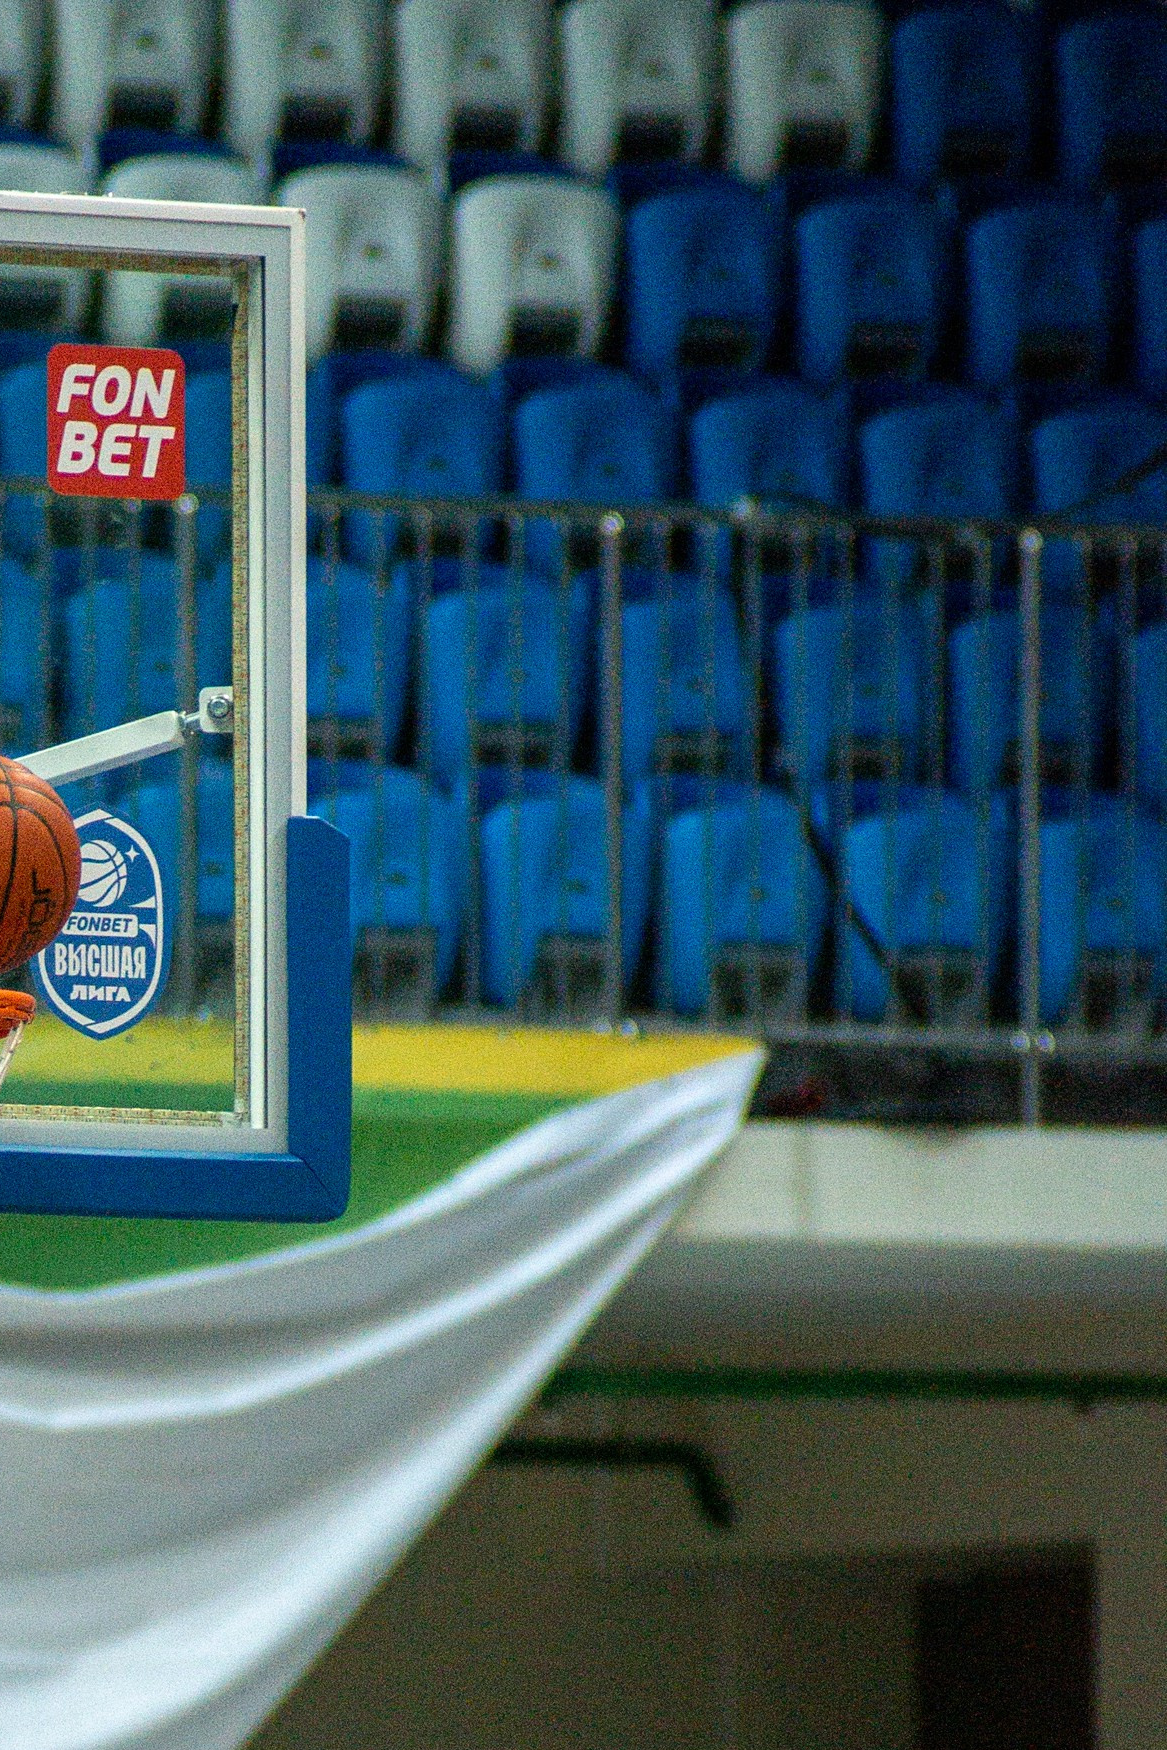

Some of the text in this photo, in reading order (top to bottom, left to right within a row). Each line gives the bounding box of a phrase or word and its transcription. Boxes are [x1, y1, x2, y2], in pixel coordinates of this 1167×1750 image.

[56, 363, 176, 419] FON
[56, 420, 176, 478] BET
[67, 916, 133, 933] FONBET
[54, 943, 146, 979] ВЫСШАЯ
[70, 984, 131, 1002] ЛИГА
